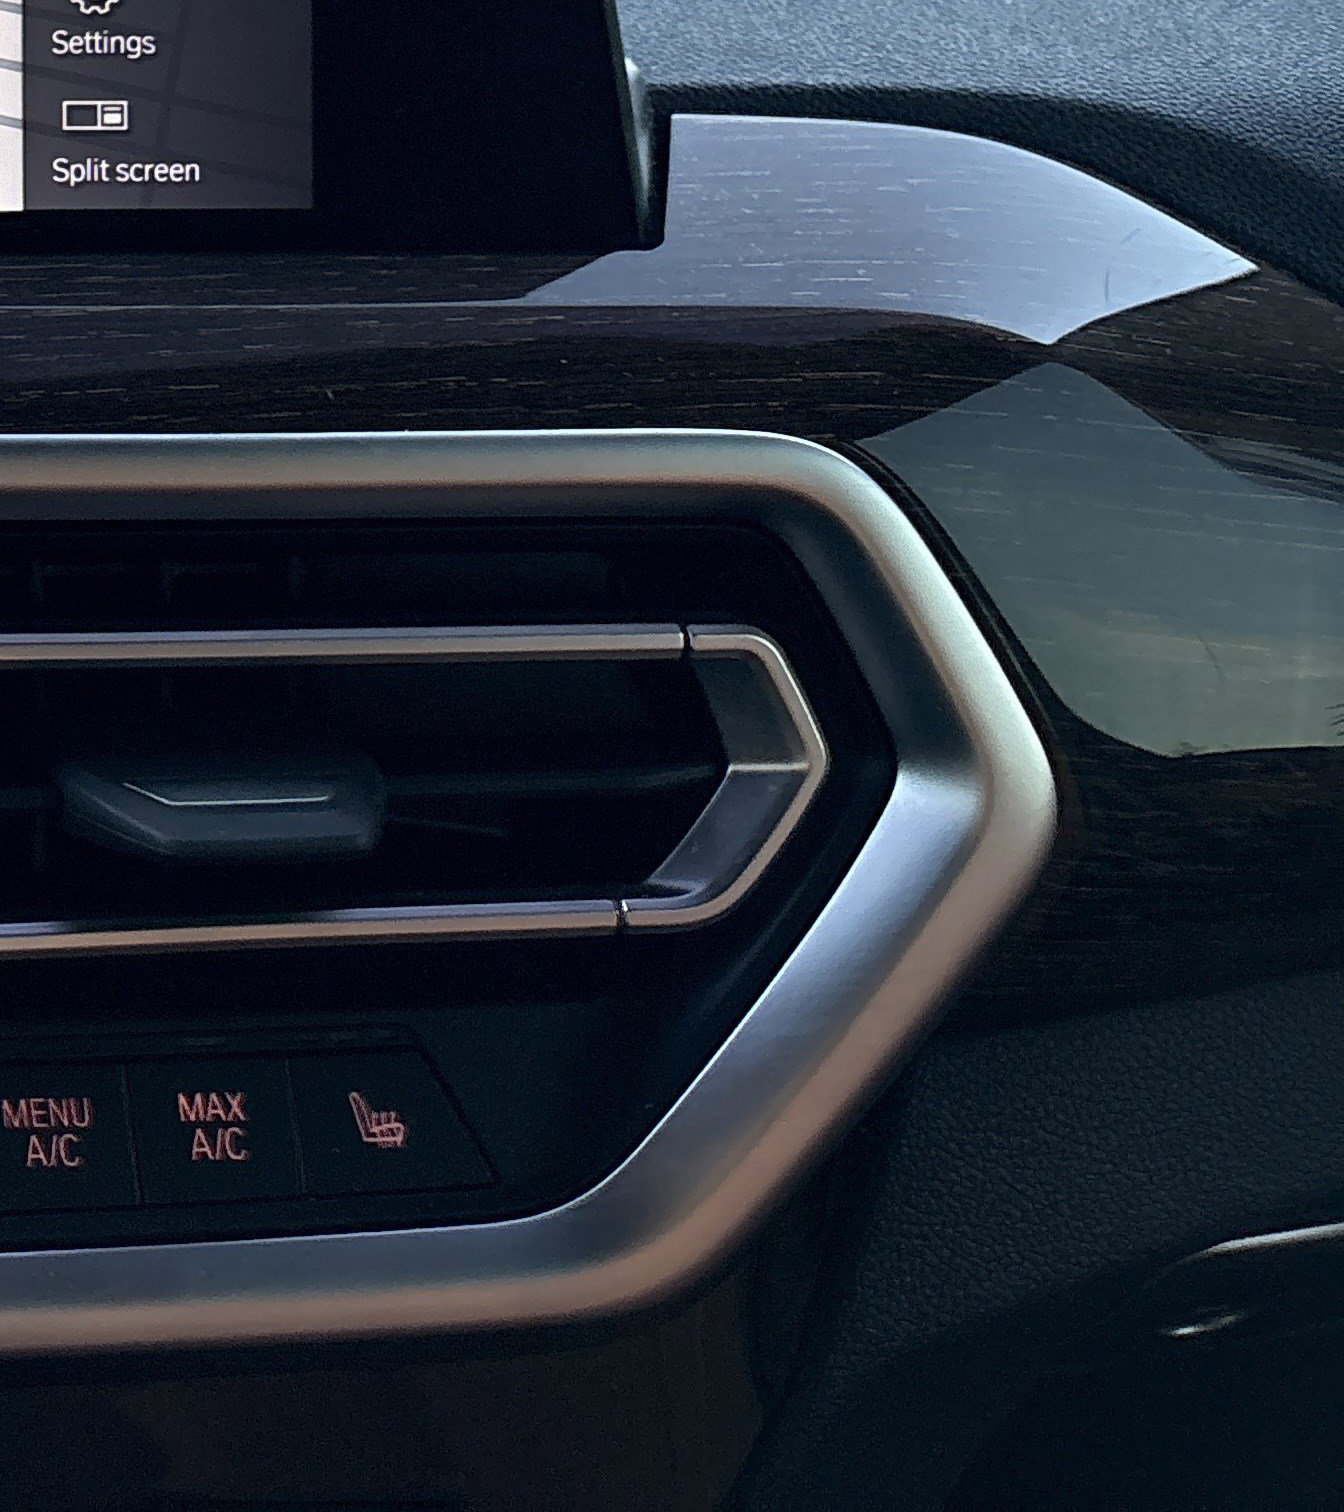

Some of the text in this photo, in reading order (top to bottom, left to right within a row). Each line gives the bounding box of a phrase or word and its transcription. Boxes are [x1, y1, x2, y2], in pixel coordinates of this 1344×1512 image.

[51, 29, 157, 59] Settings
[52, 157, 200, 186] Split screen
[2, 1098, 92, 1128] MENU
[178, 1091, 247, 1123] MAX
[26, 1134, 83, 1168] A/C
[191, 1128, 248, 1161] A/C
